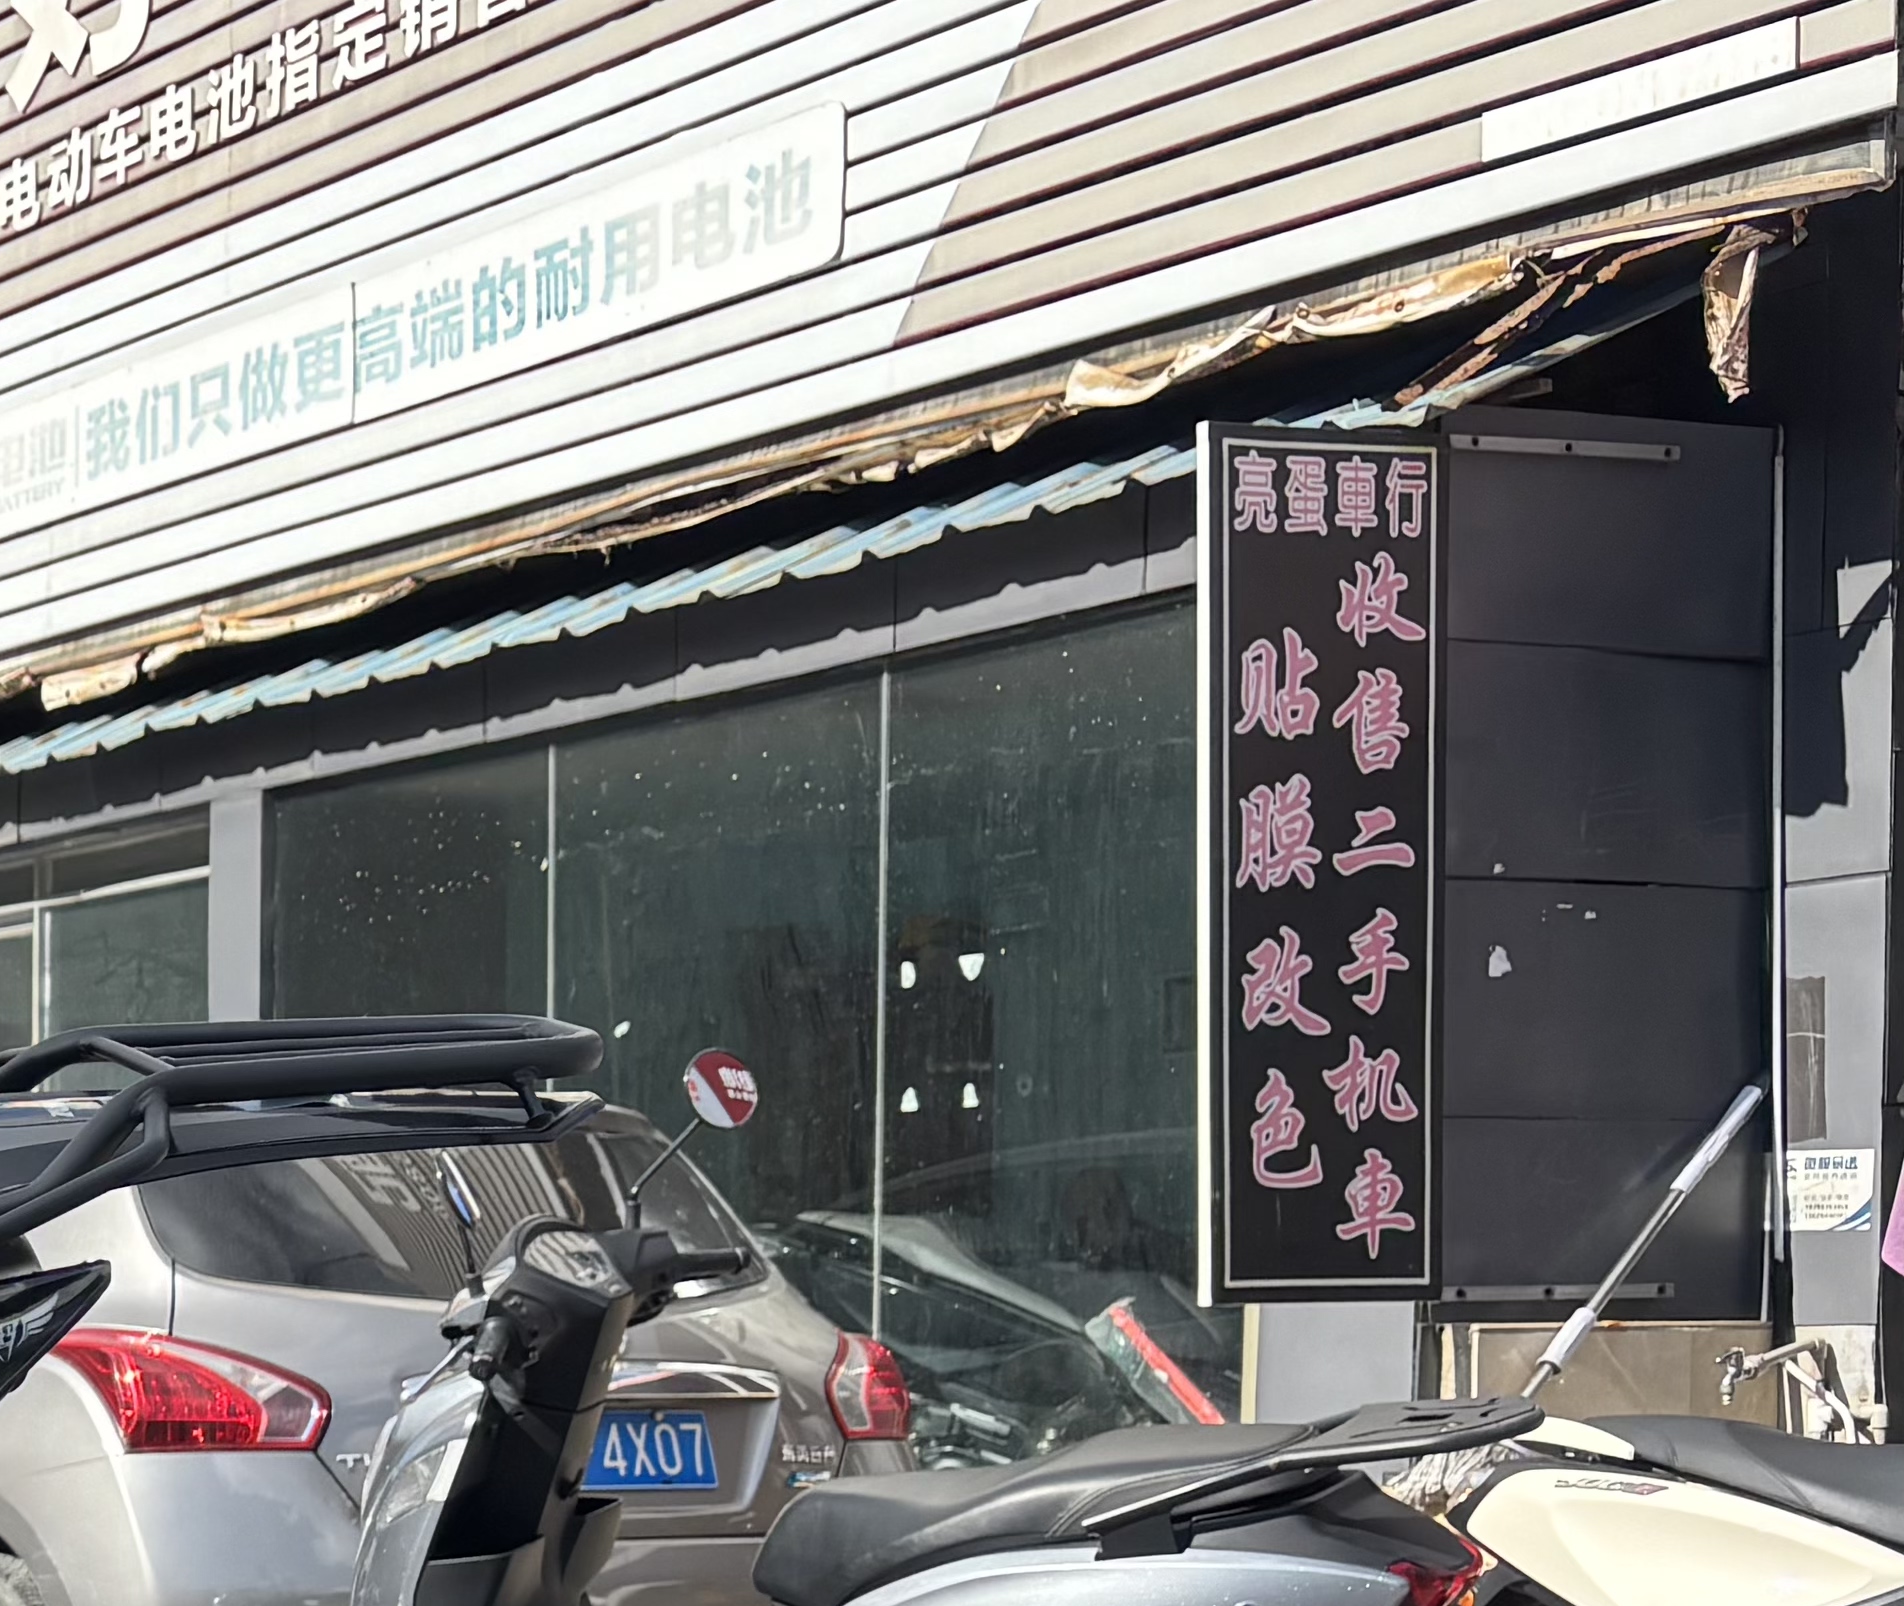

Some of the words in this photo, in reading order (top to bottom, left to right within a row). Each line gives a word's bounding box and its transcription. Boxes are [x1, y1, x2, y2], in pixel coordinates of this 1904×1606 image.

[86, 148, 812, 481] 我们只做更高端的耐用电池
[1235, 626, 1330, 1190] 贴膜改色
